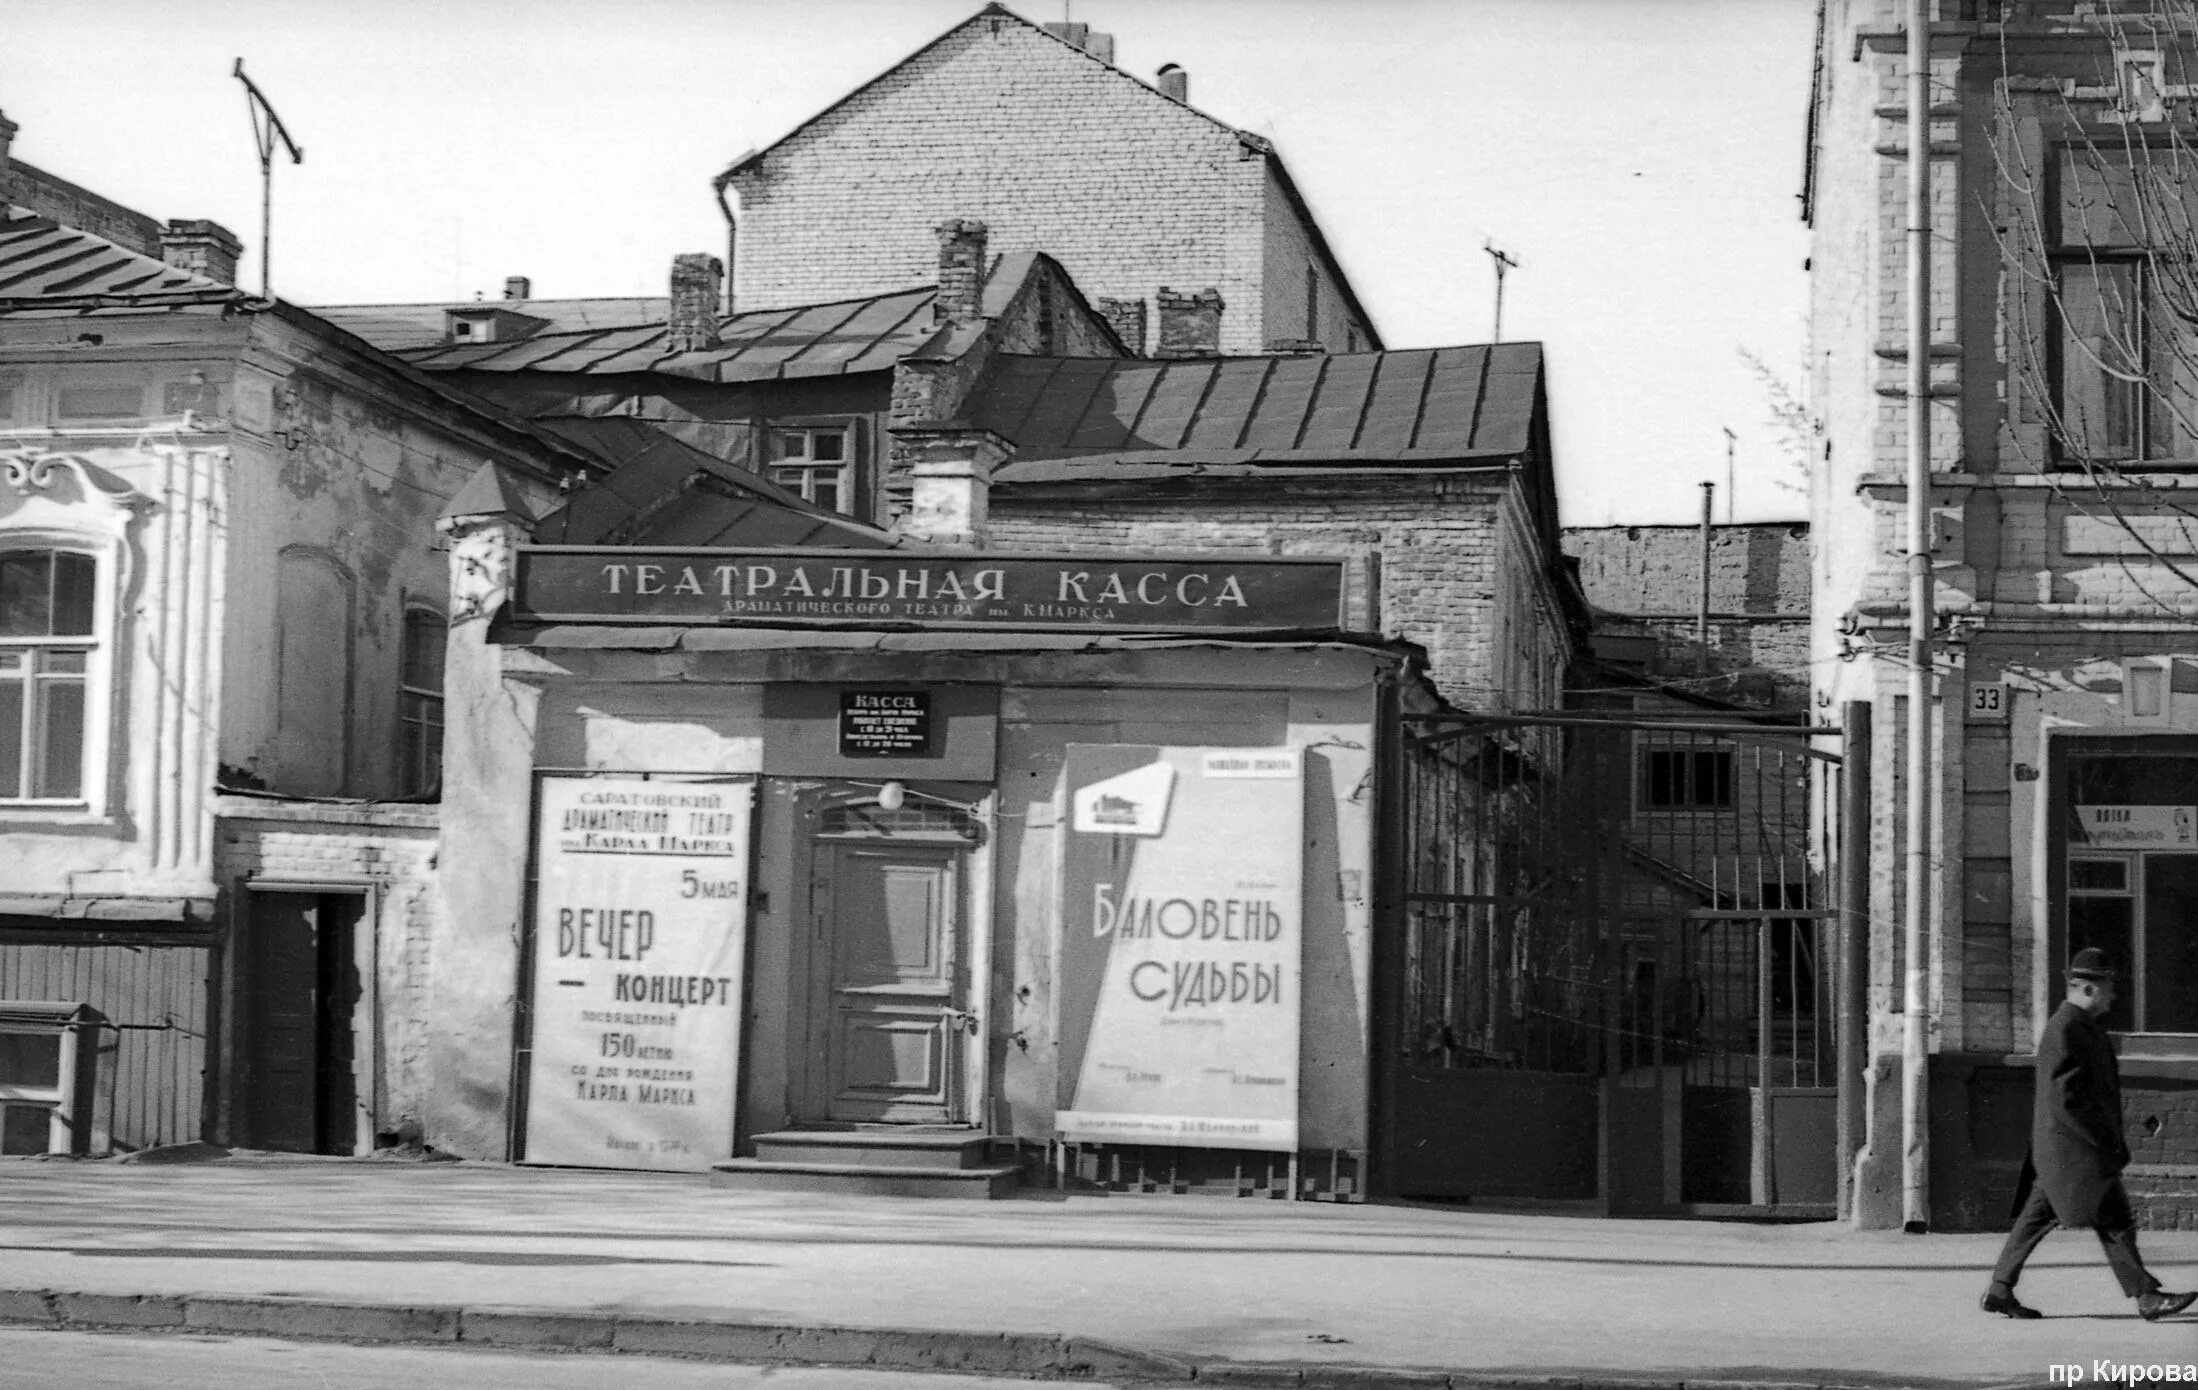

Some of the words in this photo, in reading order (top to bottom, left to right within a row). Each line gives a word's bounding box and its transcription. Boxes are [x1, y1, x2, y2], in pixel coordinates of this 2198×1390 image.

[601, 564, 1005, 600] ТЕАТРАЛЬНАЯ
[1058, 571, 1248, 608] КАССА
[722, 599, 890, 616] ДРАМАТИЧЕСКОГО
[905, 602, 974, 617] ТЕАТРА
[855, 695, 916, 708] КАССА
[1975, 688, 1999, 710] 33
[580, 792, 721, 809] САРАТОВСКИЙ
[562, 807, 668, 833] ДРАМАТИЧЕСКИЙ
[689, 811, 733, 835] ТЕАТР
[681, 869, 699, 899] 5
[702, 881, 738, 898] МАЯ
[1093, 883, 1281, 942] БАЛОВЕНЬ
[558, 907, 654, 962] ВЕЧЕР
[616, 973, 731, 1008] КОНЦЕРТ
[1130, 960, 1280, 1012] СУДЬБЫ
[602, 1032, 635, 1058] 150
